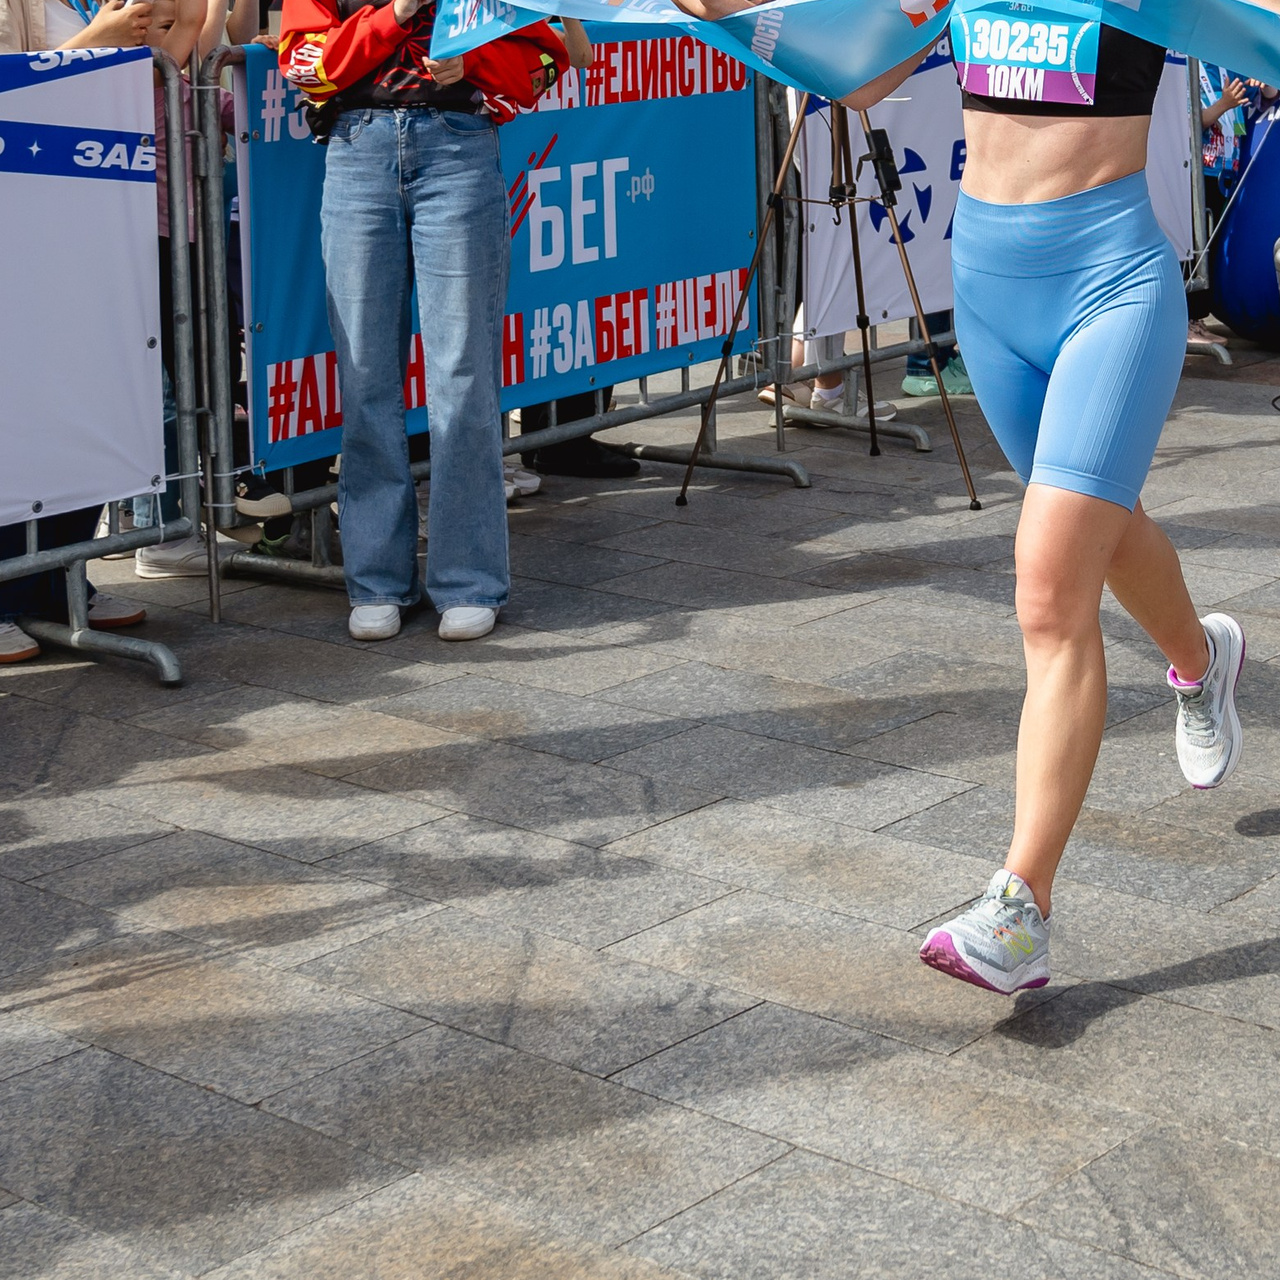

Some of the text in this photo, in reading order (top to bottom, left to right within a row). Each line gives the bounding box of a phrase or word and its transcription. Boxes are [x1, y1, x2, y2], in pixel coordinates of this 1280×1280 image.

[585, 34, 747, 107] #ЕДИНСТВО
[971, 18, 1070, 66] 30235
[530, 287, 649, 376] #ЗАБЕГ
